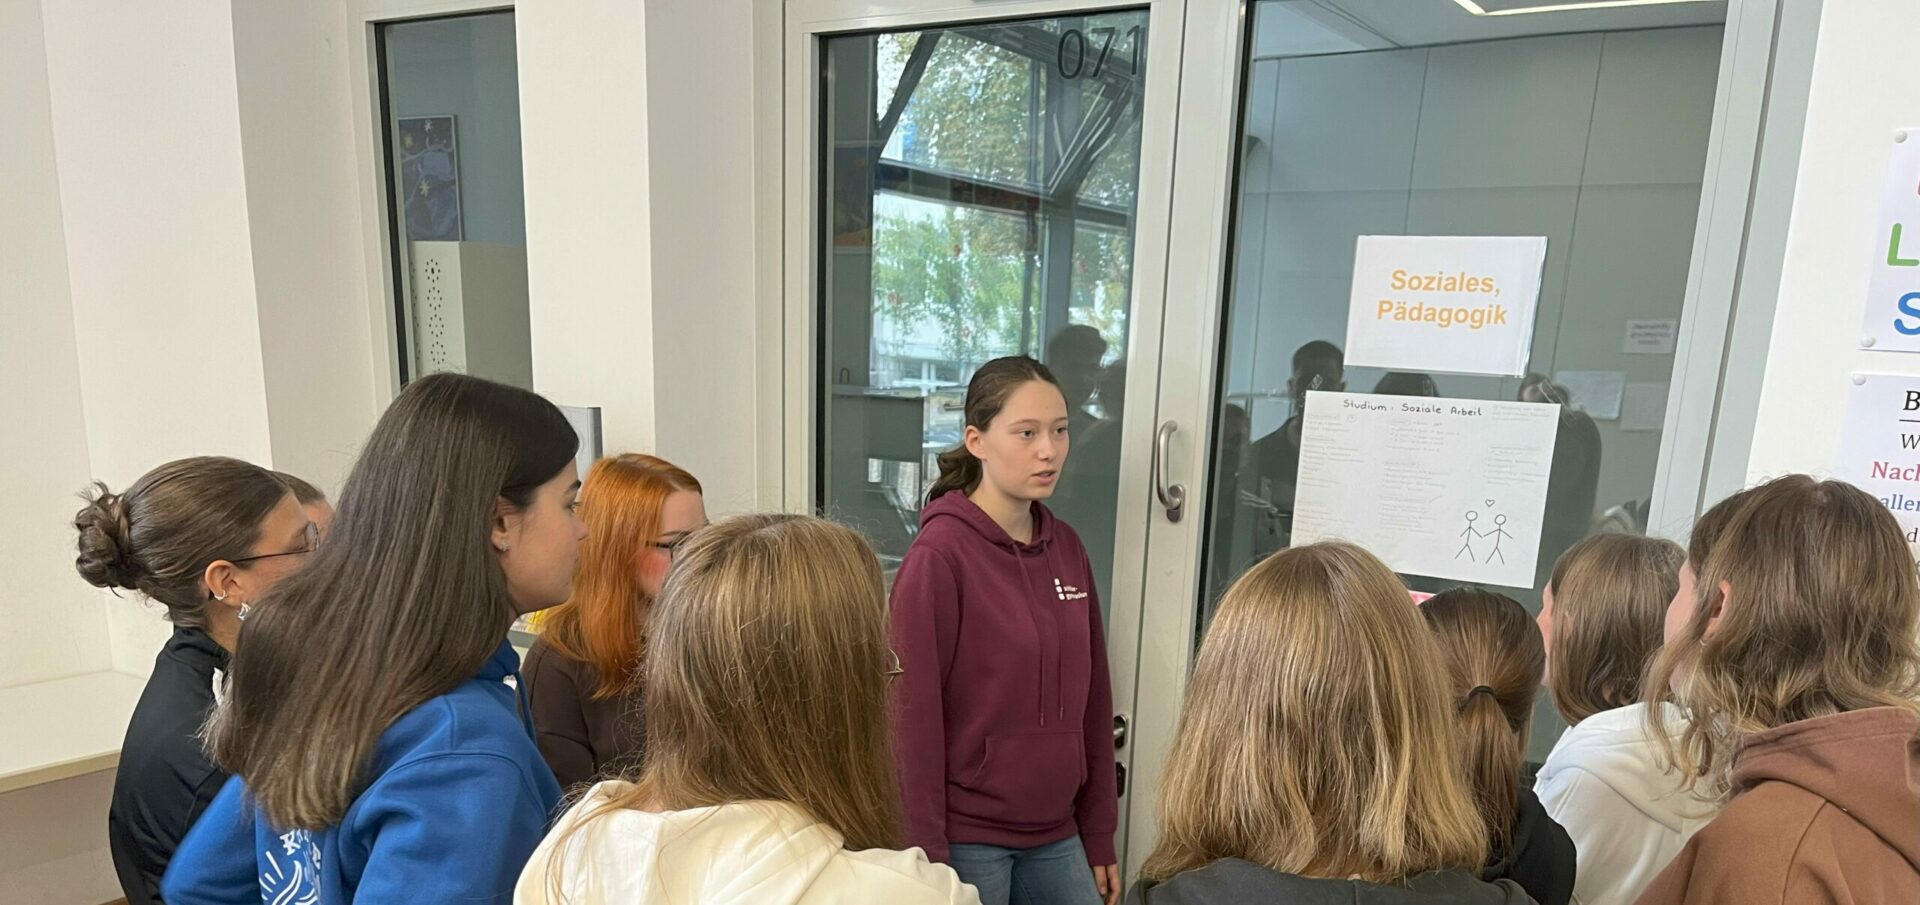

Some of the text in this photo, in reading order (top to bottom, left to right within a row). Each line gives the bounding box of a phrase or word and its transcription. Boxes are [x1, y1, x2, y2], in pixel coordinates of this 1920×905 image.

[1057, 24, 1141, 80] 071
[1390, 268, 1501, 297] Soziales,
[1377, 299, 1508, 330] Pädagogik
[1401, 403, 1443, 414] Soziale
[1450, 406, 1483, 416] Arbeit
